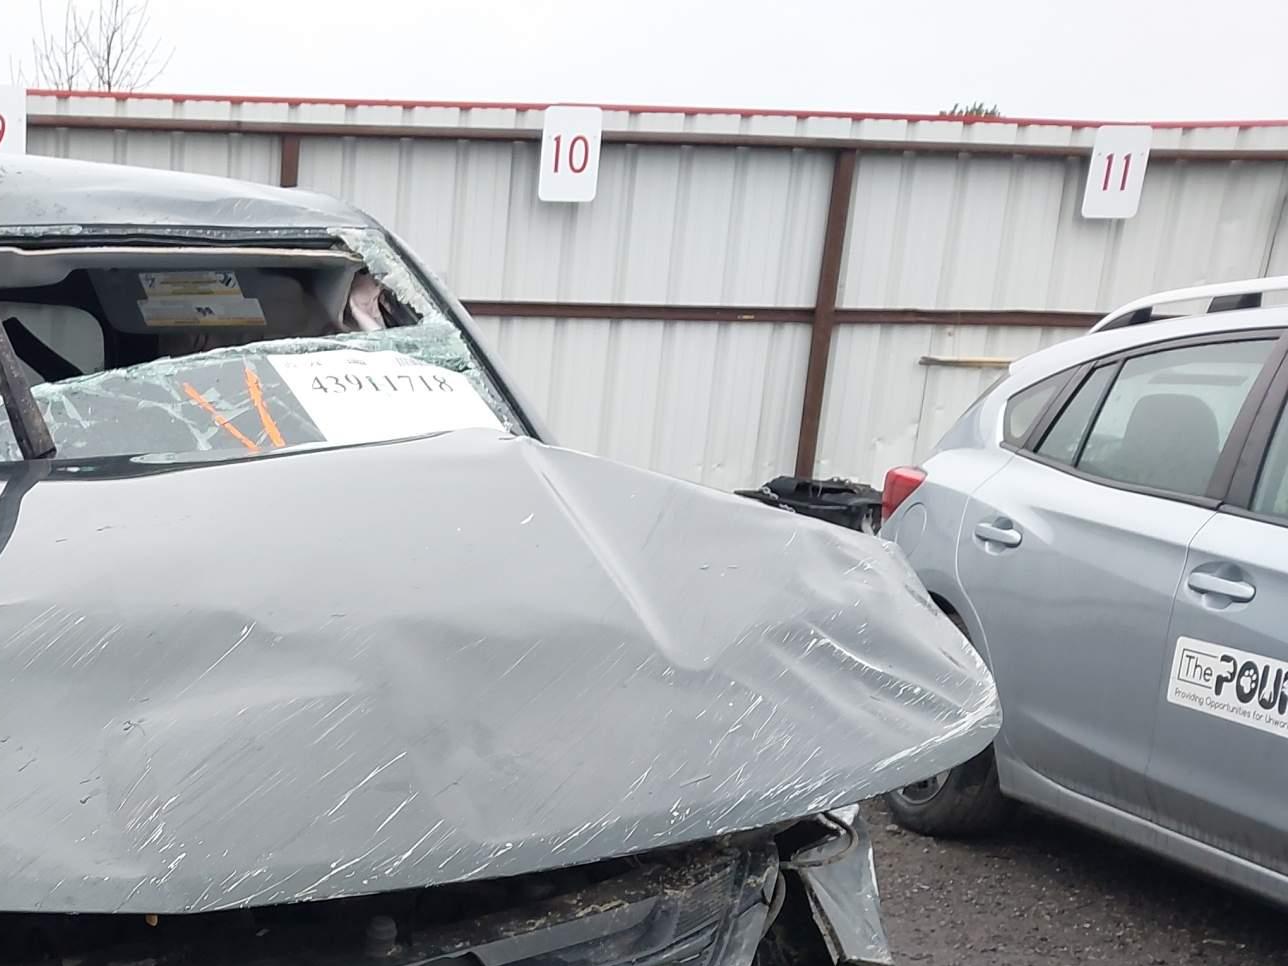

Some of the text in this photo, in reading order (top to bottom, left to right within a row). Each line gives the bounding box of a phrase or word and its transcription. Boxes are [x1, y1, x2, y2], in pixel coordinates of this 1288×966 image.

[553, 134, 590, 174] 10
[1102, 153, 1132, 191] 11
[311, 373, 455, 394] 43911718
[1185, 654, 1213, 682] The
[1175, 687, 1205, 706] Providing
[1205, 696, 1251, 719] Opportunities
[1252, 710, 1263, 721] for
